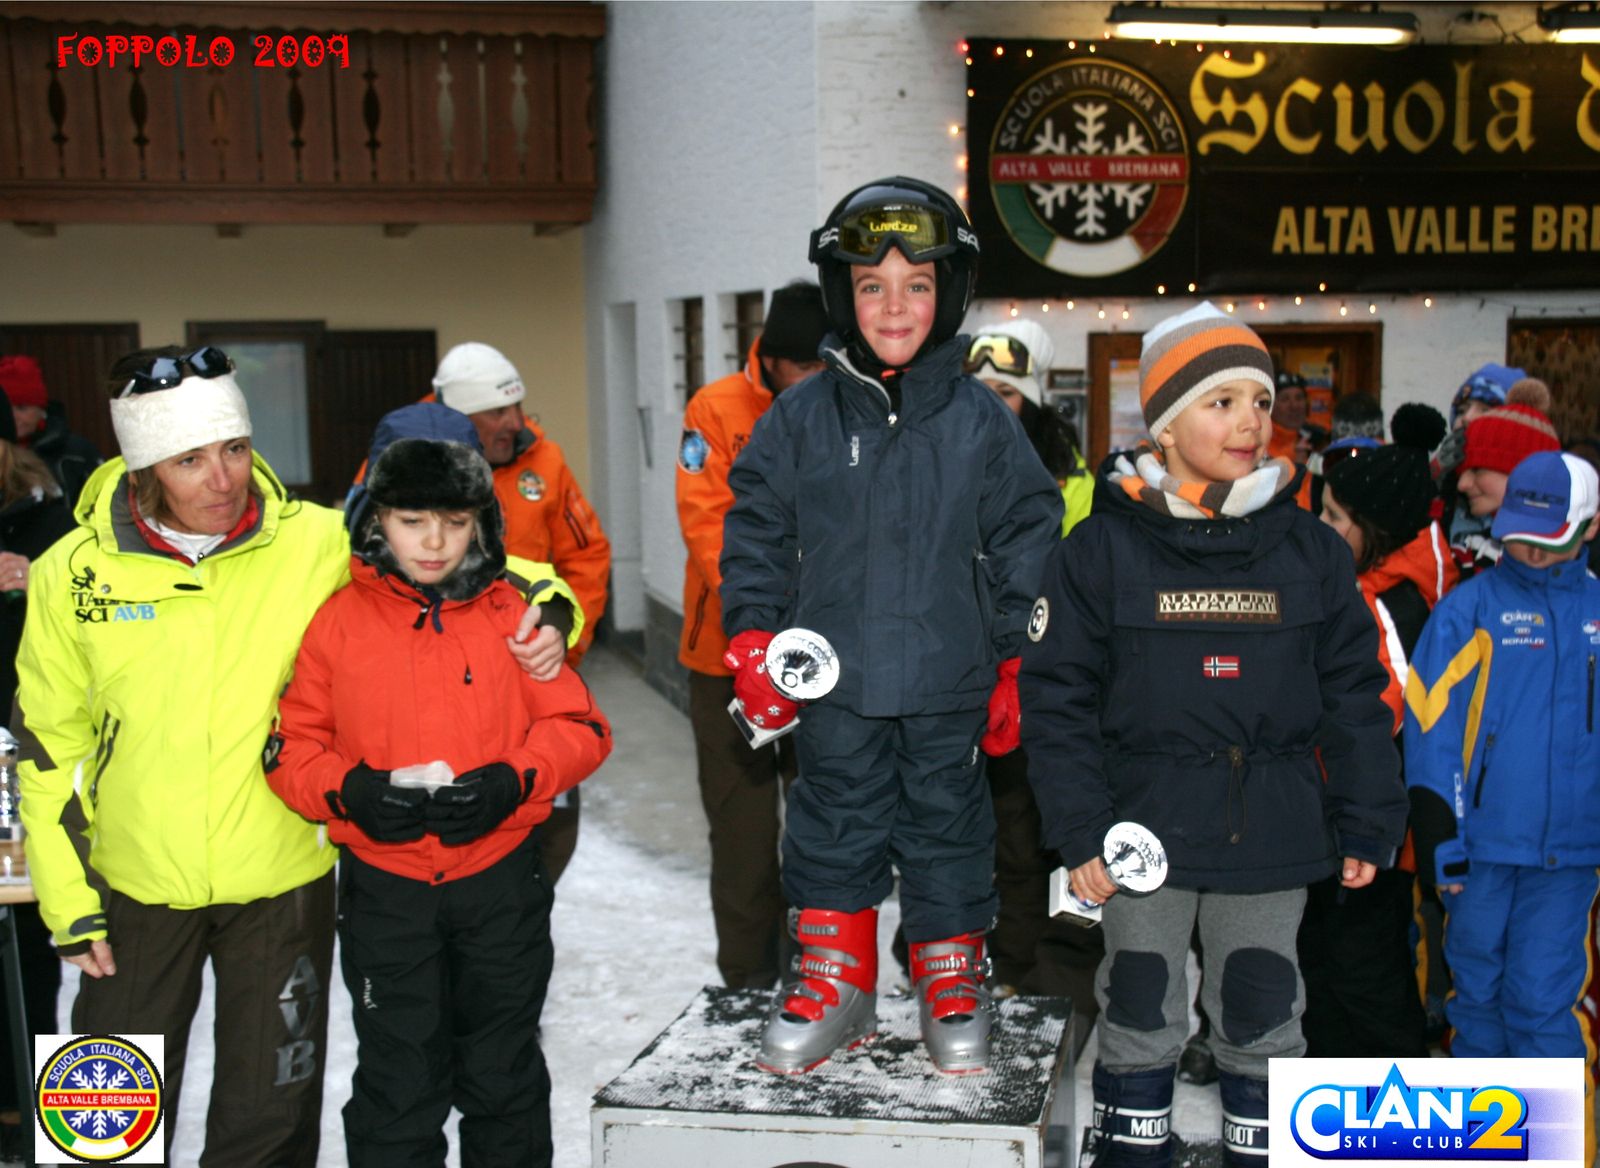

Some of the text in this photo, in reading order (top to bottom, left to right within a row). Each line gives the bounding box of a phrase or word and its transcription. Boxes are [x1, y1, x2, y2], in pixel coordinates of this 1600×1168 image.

[1000, 66, 1179, 151] SCUOLA ITALIANA SCI
[1190, 51, 1536, 155] Scuola
[1000, 161, 1181, 177] ALTA VALLE BREMBANA
[1272, 206, 1375, 254] ALTA
[1387, 206, 1517, 254] VALLE
[75, 604, 155, 623] SCI AVB
[1160, 592, 1277, 614] NAPAPIJRI
